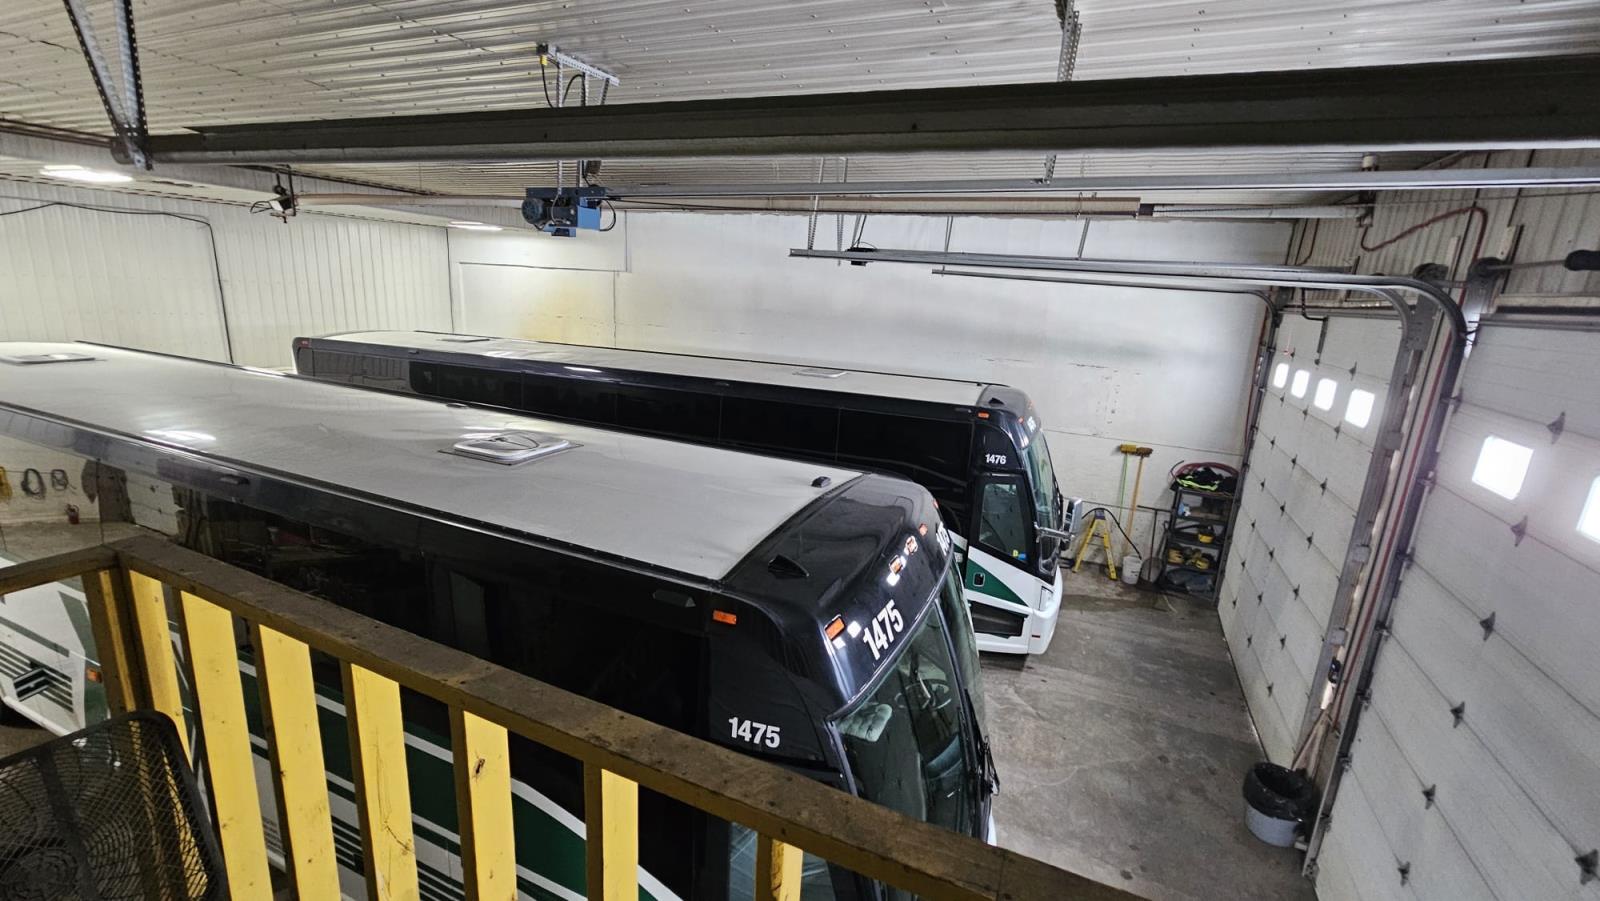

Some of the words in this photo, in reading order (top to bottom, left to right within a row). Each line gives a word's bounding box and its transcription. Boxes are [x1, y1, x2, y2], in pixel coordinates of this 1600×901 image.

[984, 453, 1008, 465] 1476
[862, 599, 904, 660] 1475
[728, 716, 781, 748] 1475
